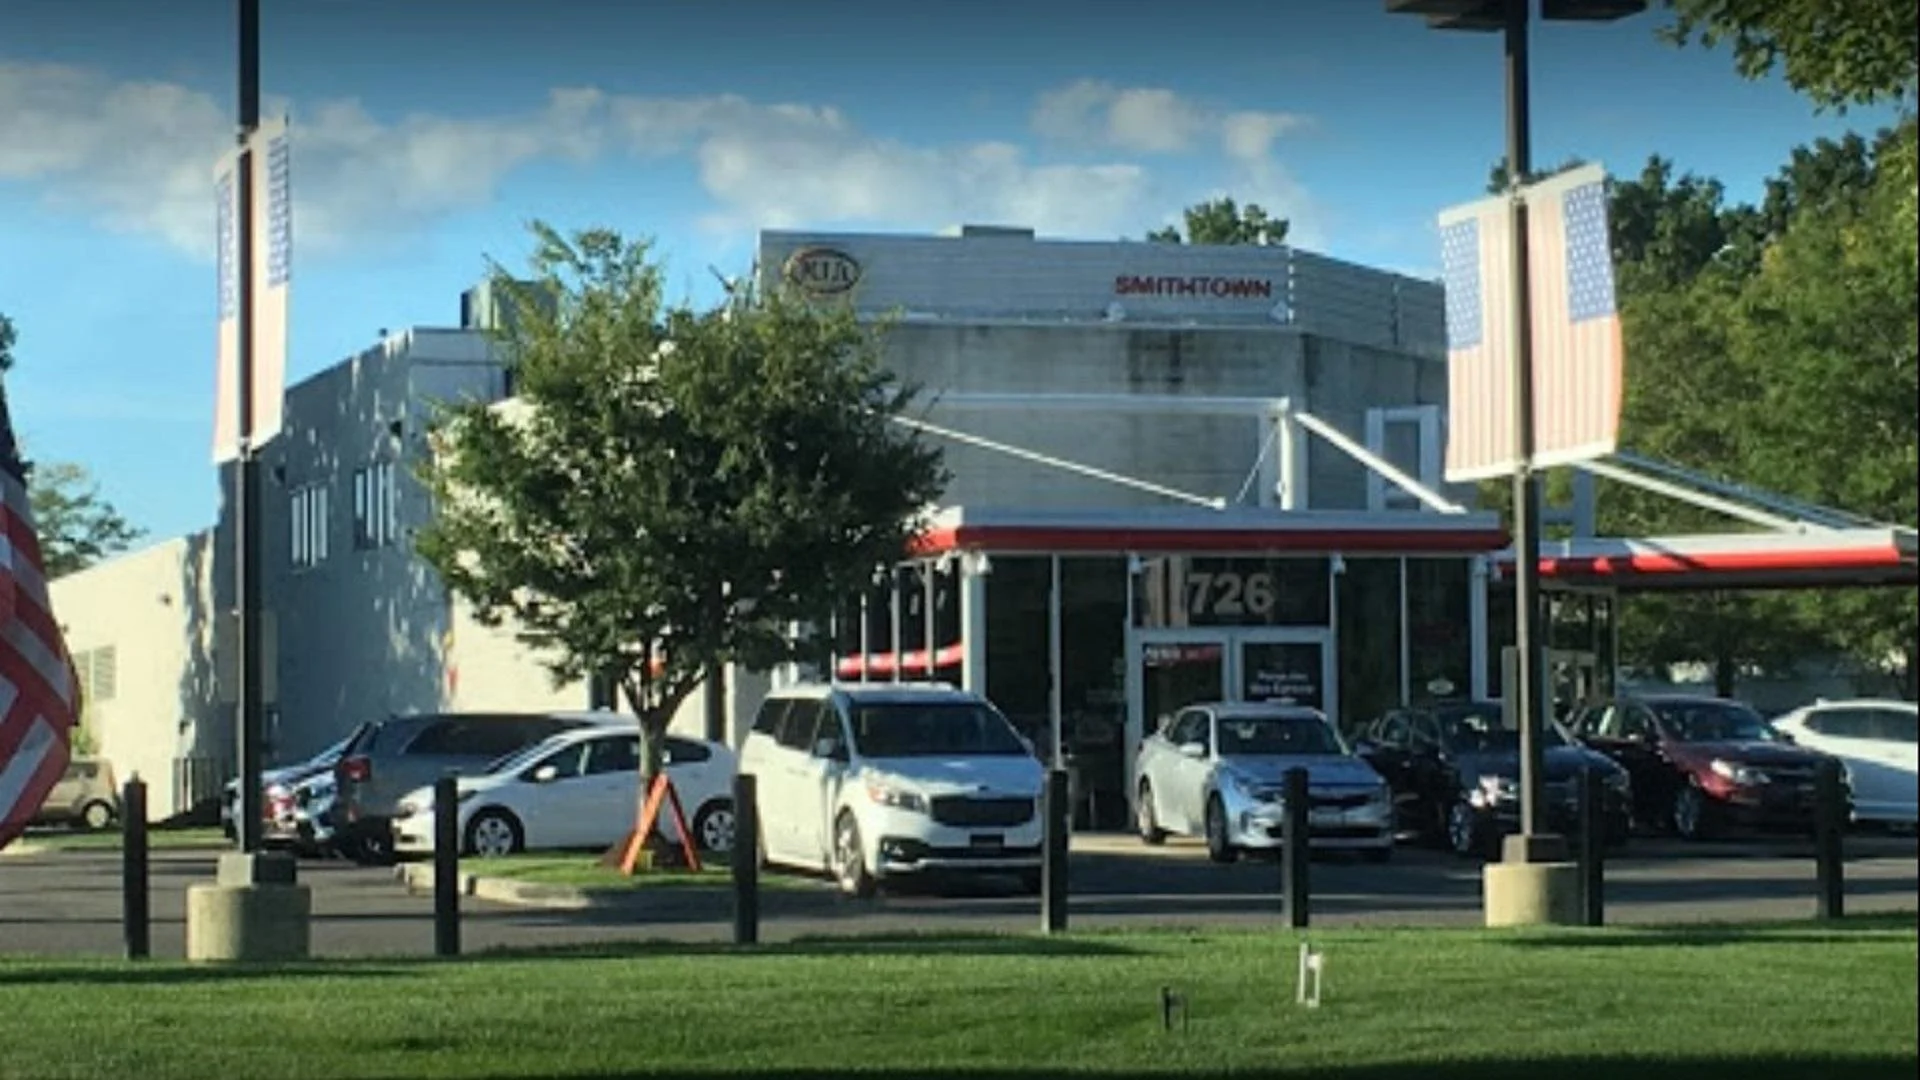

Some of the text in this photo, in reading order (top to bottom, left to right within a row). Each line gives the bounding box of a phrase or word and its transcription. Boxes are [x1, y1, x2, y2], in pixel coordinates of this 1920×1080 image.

[800, 258, 854, 284] KIA
[1114, 275, 1272, 298] SMITHTOWN
[1187, 571, 1275, 615] 726
